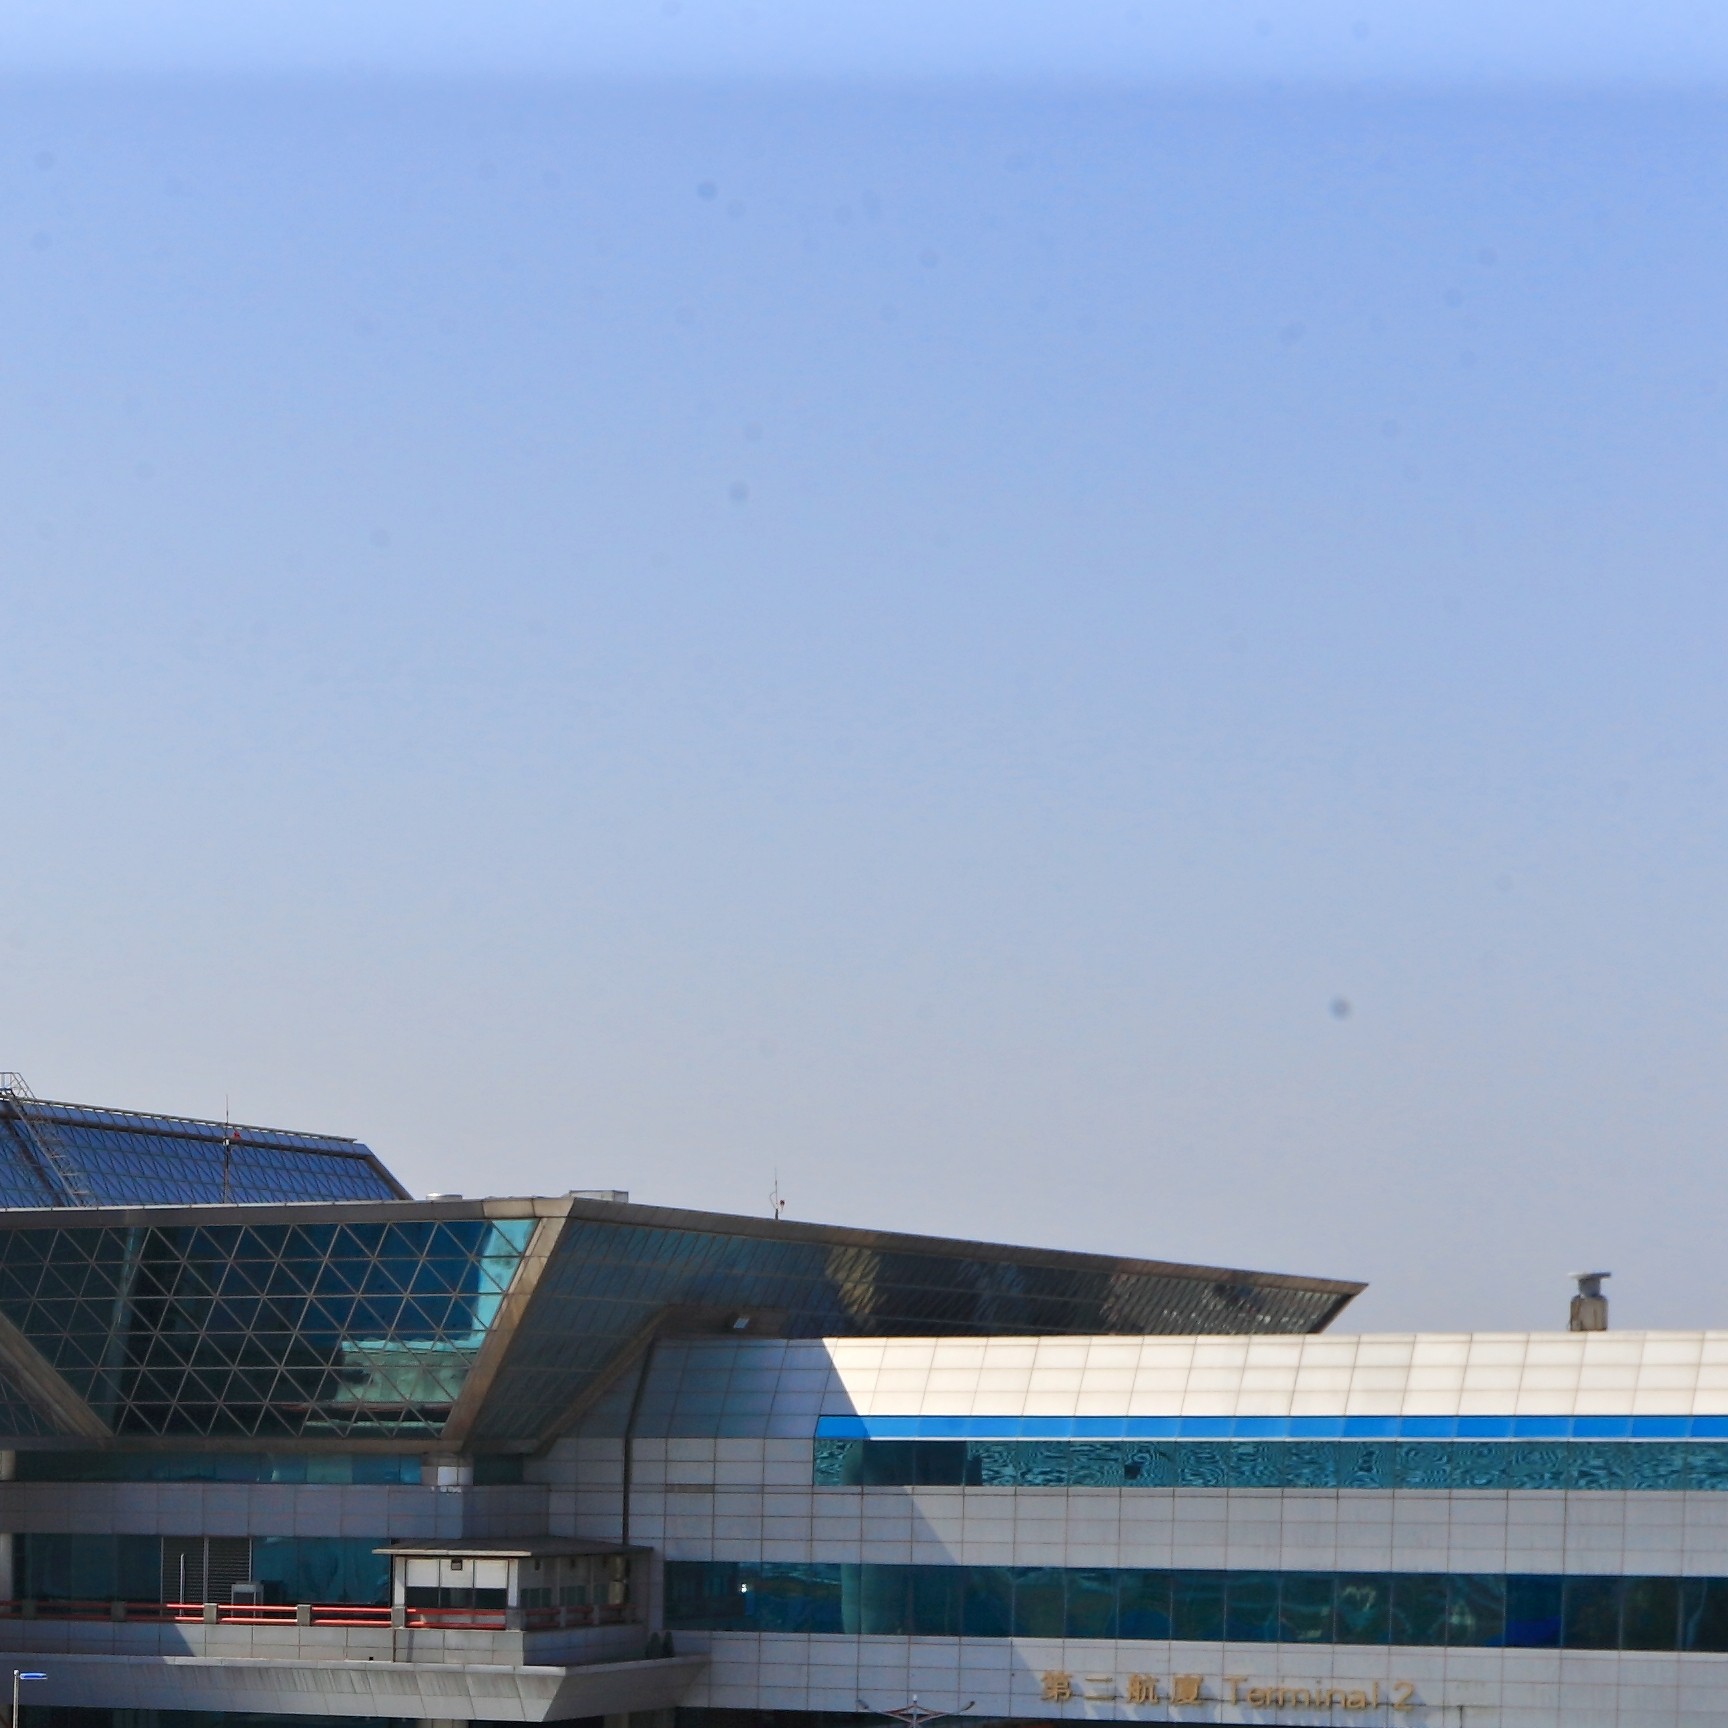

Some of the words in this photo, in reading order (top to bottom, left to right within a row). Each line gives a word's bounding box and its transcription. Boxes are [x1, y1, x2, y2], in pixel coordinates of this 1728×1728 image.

[1040, 1669, 1204, 1707] 第二航廈
[1222, 1676, 1379, 1711] Terminal
[1392, 1682, 1415, 1713] 2
